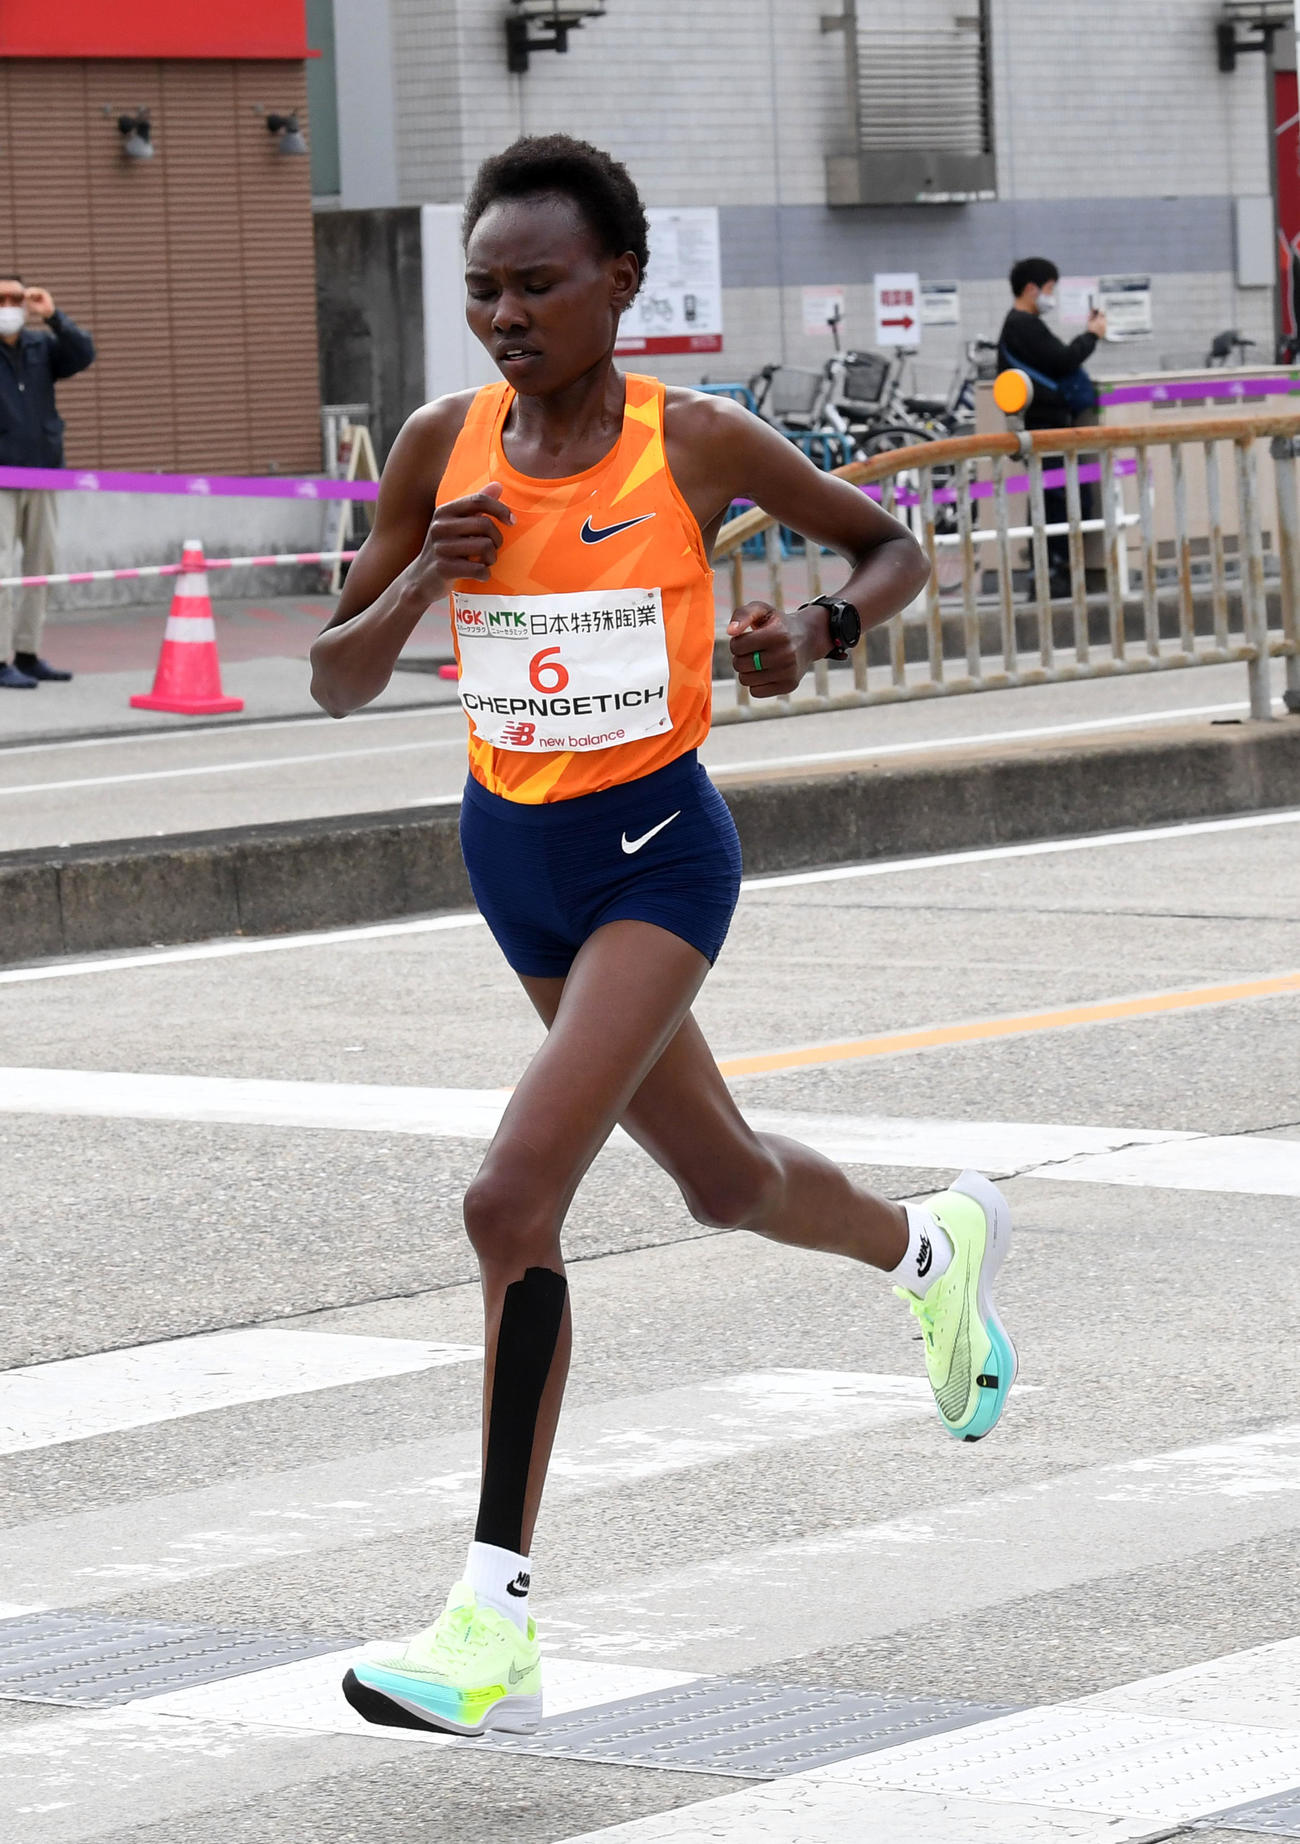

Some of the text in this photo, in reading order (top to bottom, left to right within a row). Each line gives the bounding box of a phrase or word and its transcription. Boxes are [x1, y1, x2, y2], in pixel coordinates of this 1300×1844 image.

[456, 608, 527, 627] NGK NTK
[530, 604, 657, 635] 日本特殊陶業
[529, 646, 569, 694] 6
[463, 686, 664, 716] CHEPNGETICH
[539, 728, 625, 747] new balance
[916, 1234, 929, 1267] NIKE
